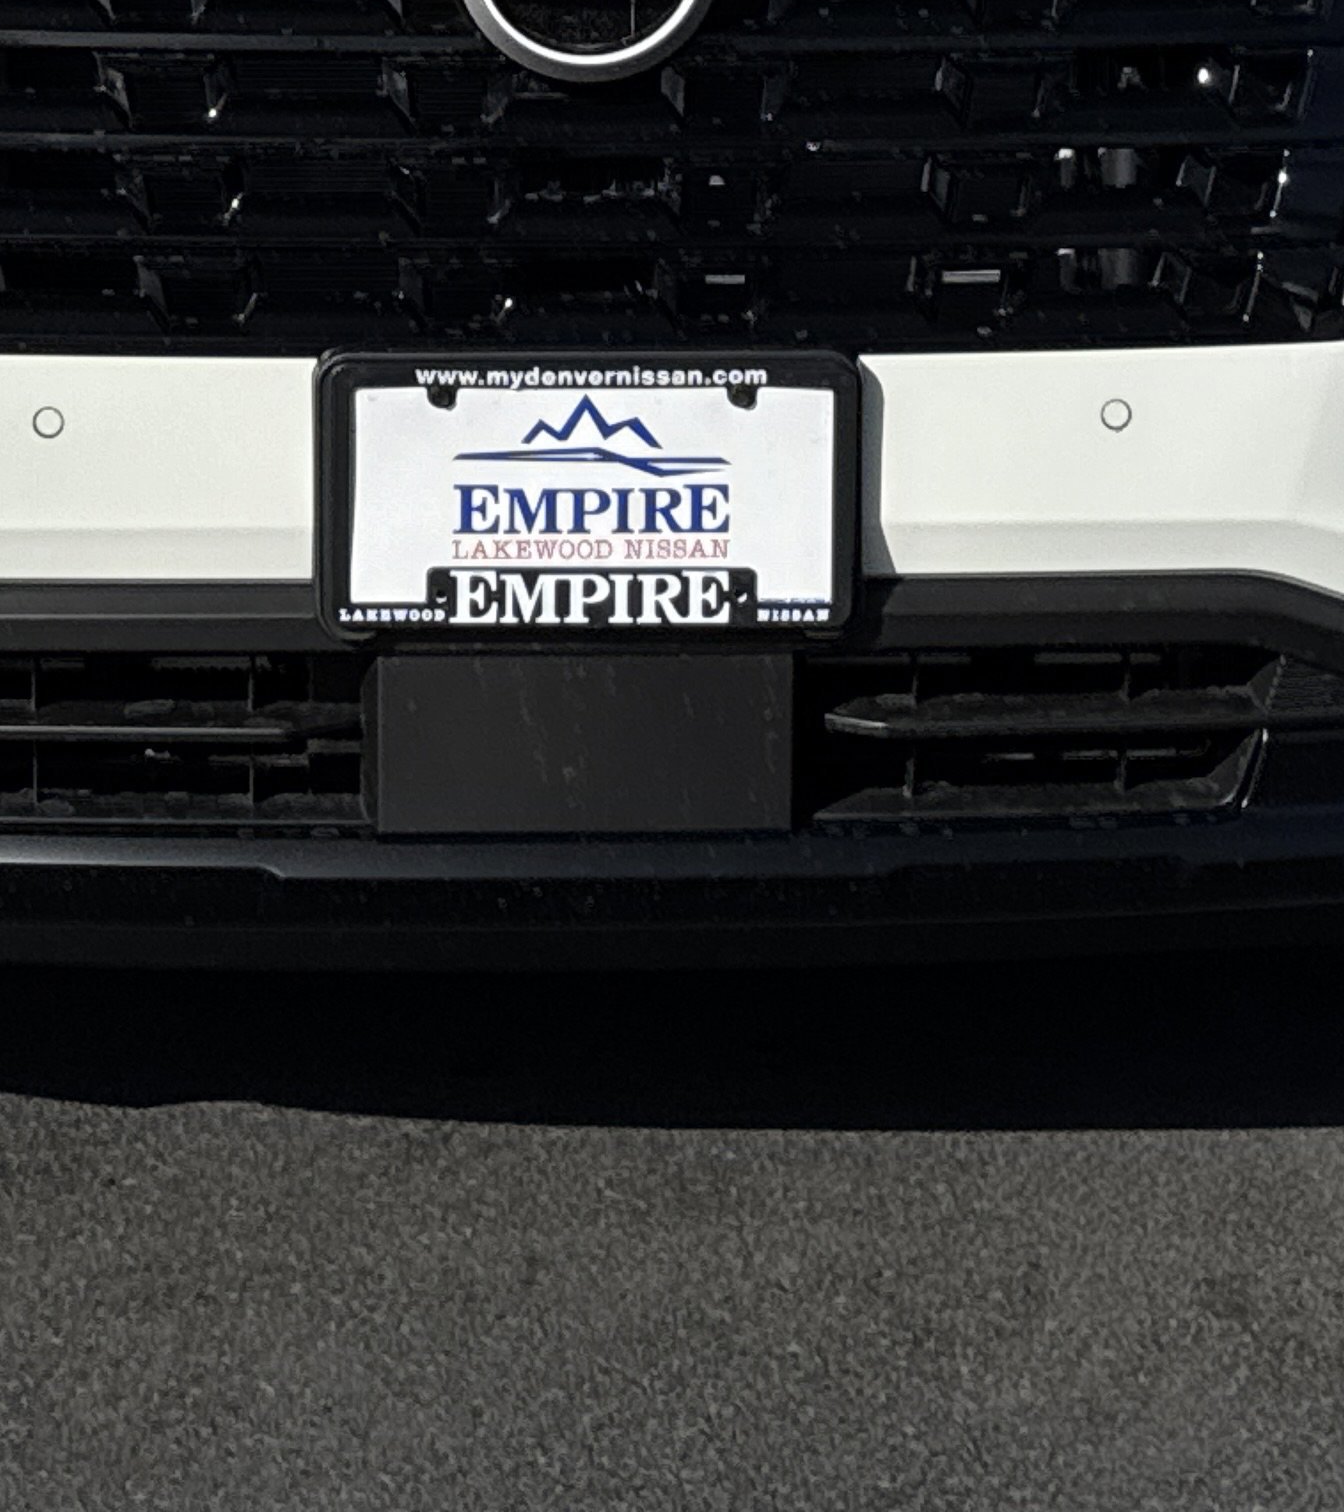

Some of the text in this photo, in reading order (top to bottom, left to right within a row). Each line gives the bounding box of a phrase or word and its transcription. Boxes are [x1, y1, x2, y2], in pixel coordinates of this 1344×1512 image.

[452, 484, 730, 535] EMPIRE
[451, 538, 730, 560] LAKEWOOD NISSAN
[338, 607, 446, 622] LAKEWOOD
[448, 569, 730, 624] EMPIRE
